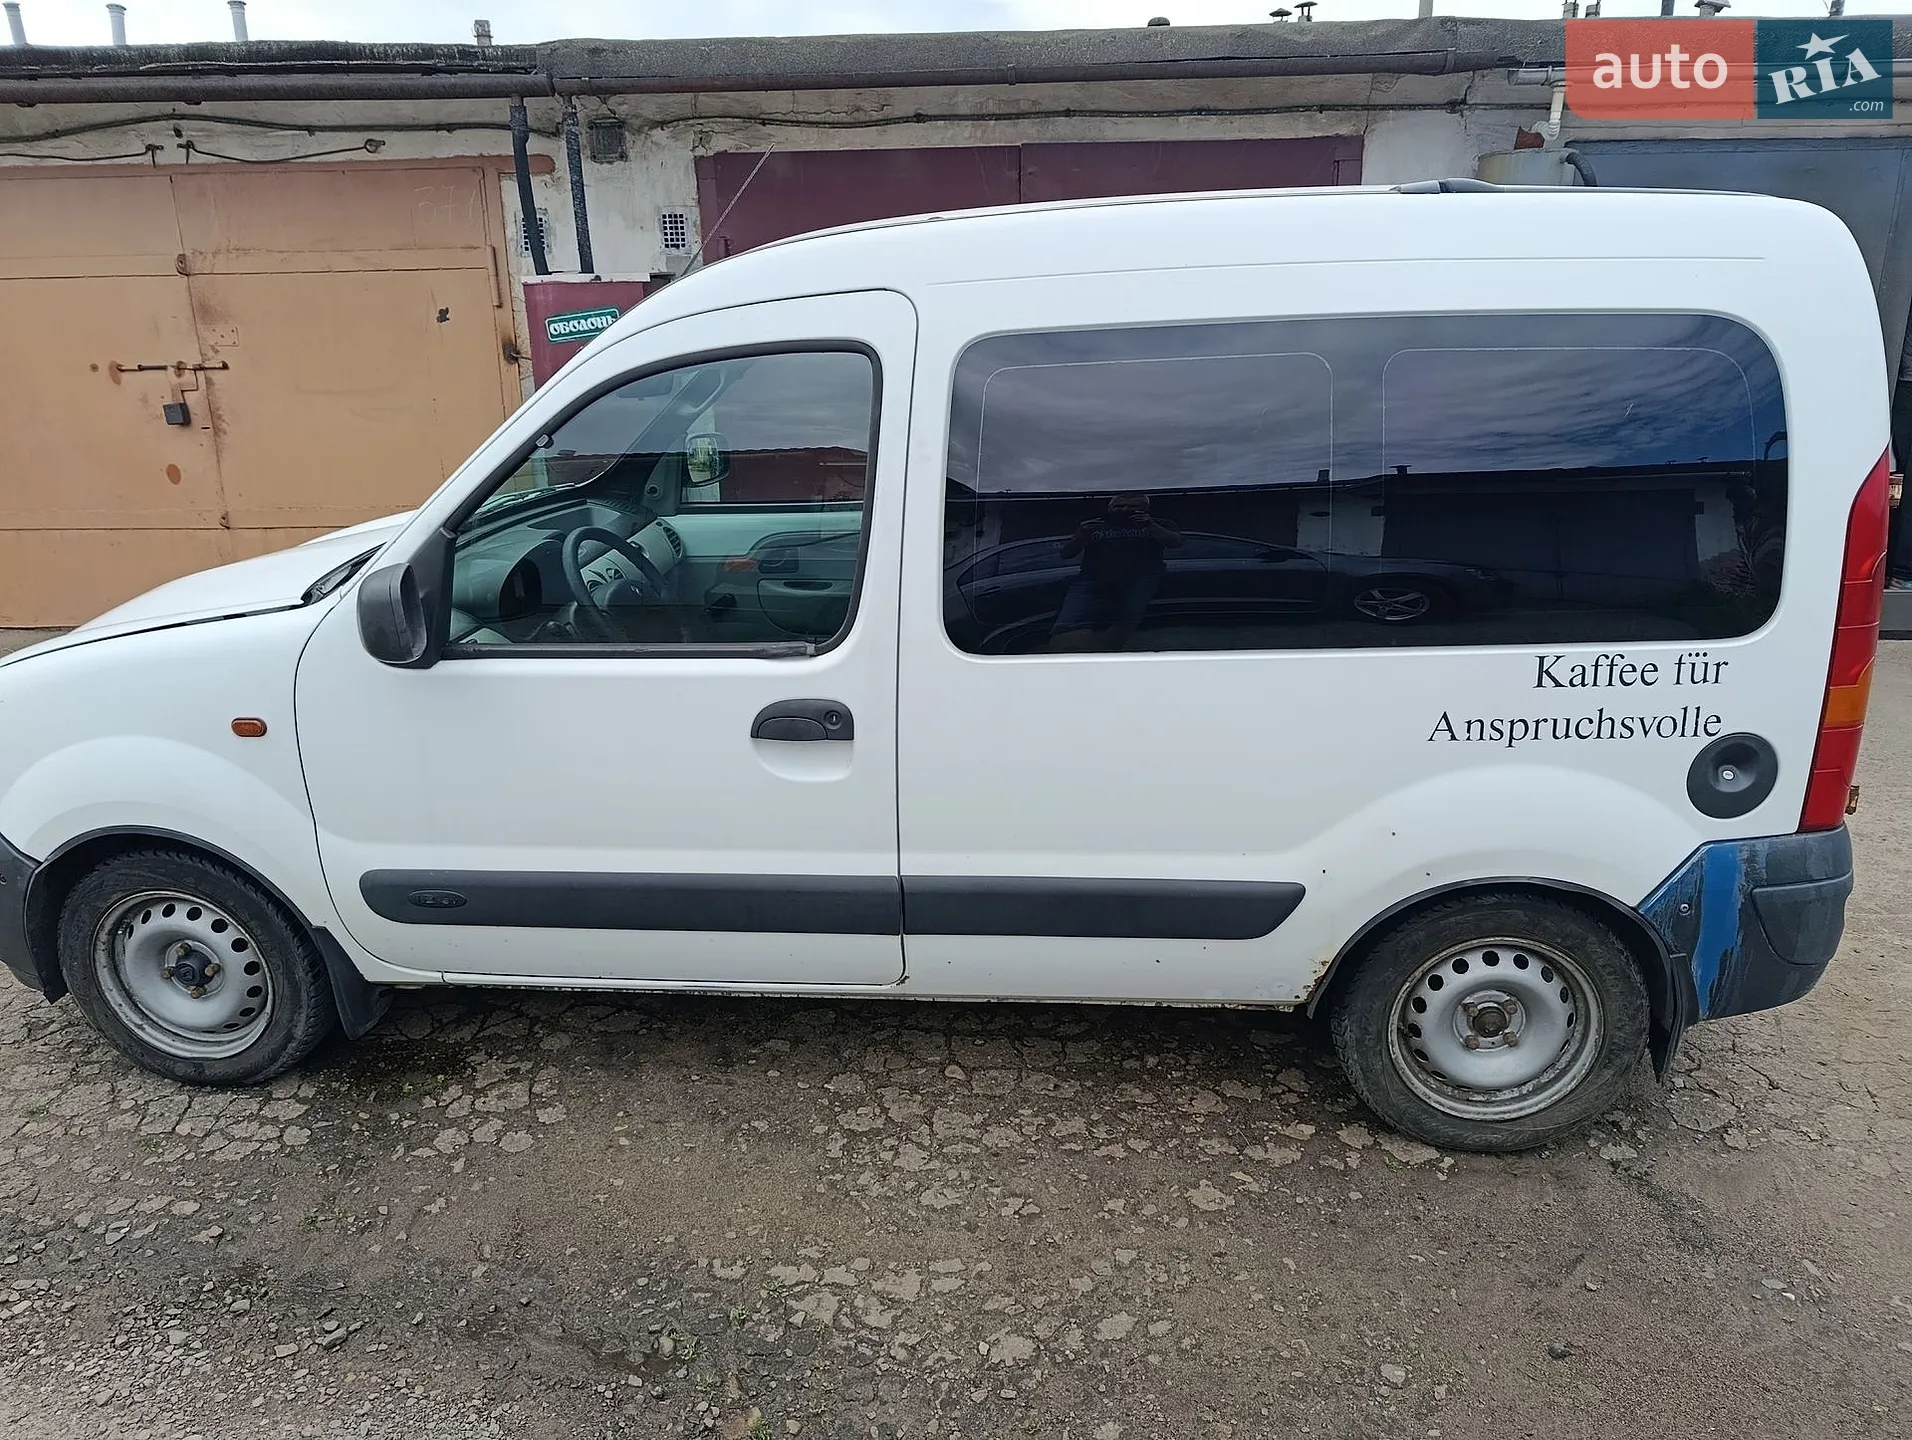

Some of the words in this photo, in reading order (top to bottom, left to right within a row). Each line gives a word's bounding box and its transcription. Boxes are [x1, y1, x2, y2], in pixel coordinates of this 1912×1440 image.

[1532, 653, 1659, 689] Kaffee
[1673, 651, 1729, 686] für
[1426, 705, 1722, 748] Anspruchsvolle
